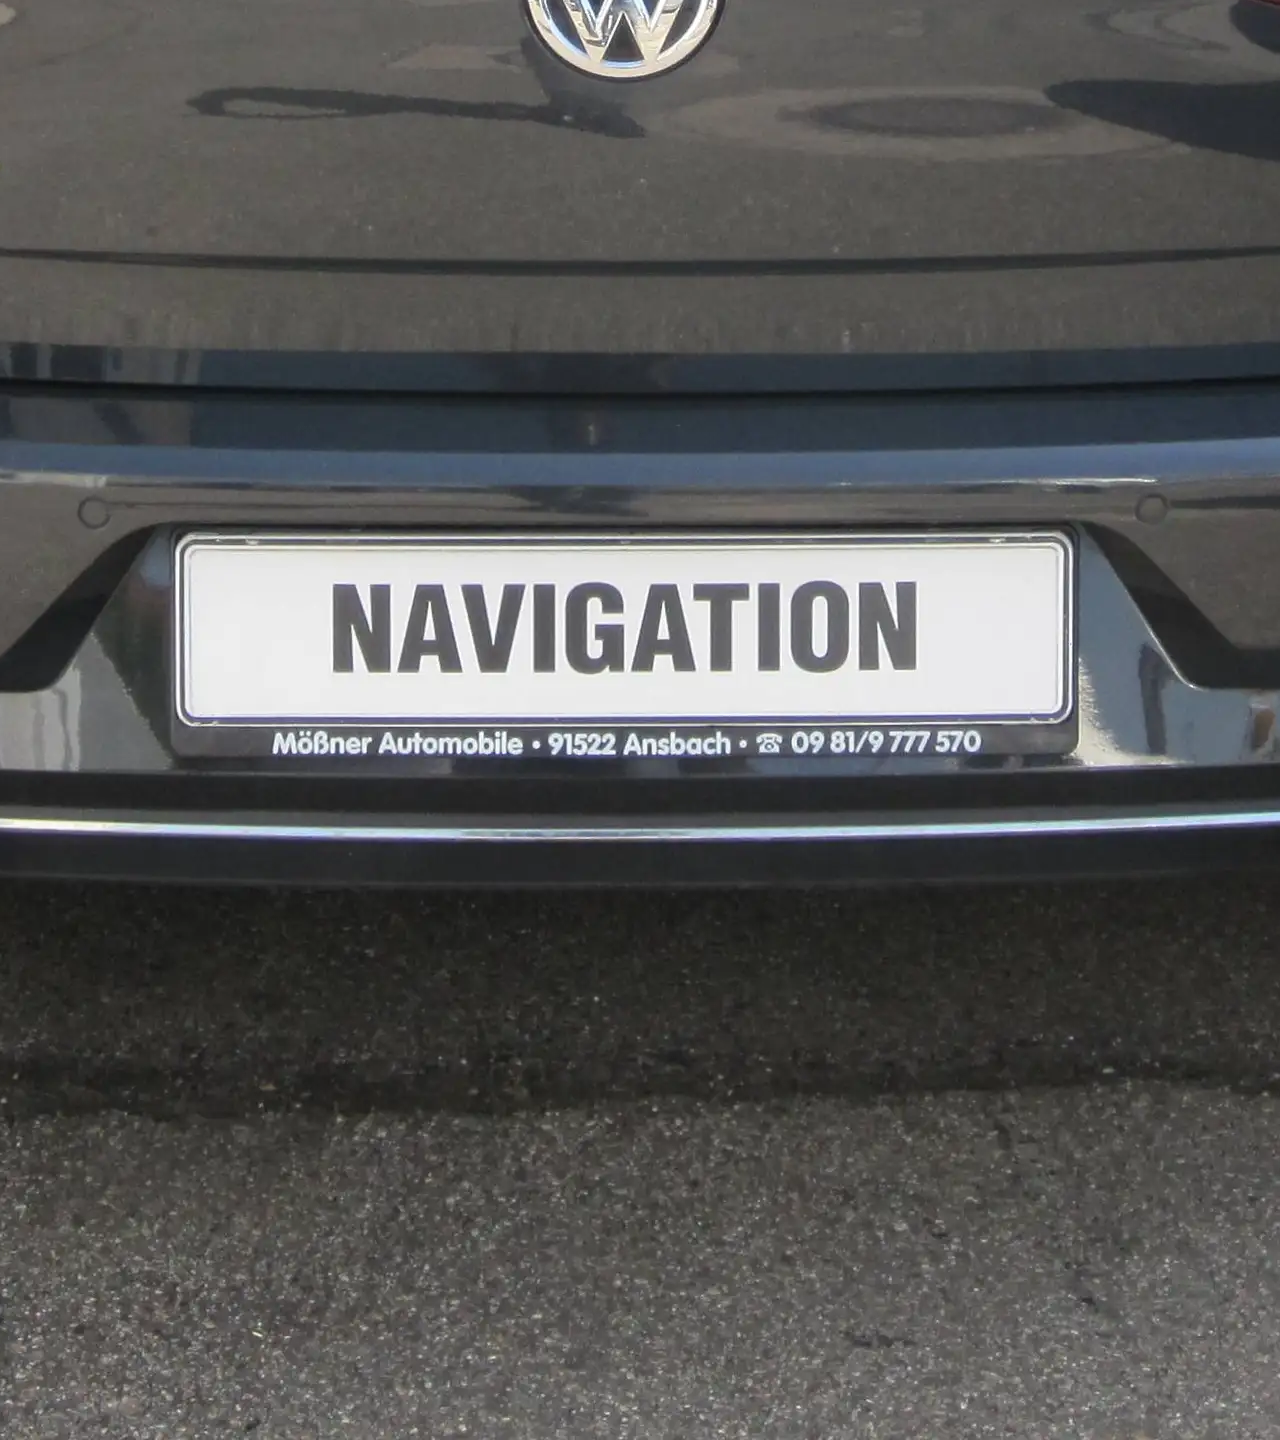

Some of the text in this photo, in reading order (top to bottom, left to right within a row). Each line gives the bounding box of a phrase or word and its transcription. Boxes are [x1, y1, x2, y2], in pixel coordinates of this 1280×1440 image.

[330, 580, 919, 675] NAVIGATION
[272, 729, 372, 757] Mößner
[377, 729, 524, 757] Automobile
[548, 731, 617, 757] 91522
[623, 730, 732, 757] Ansbach
